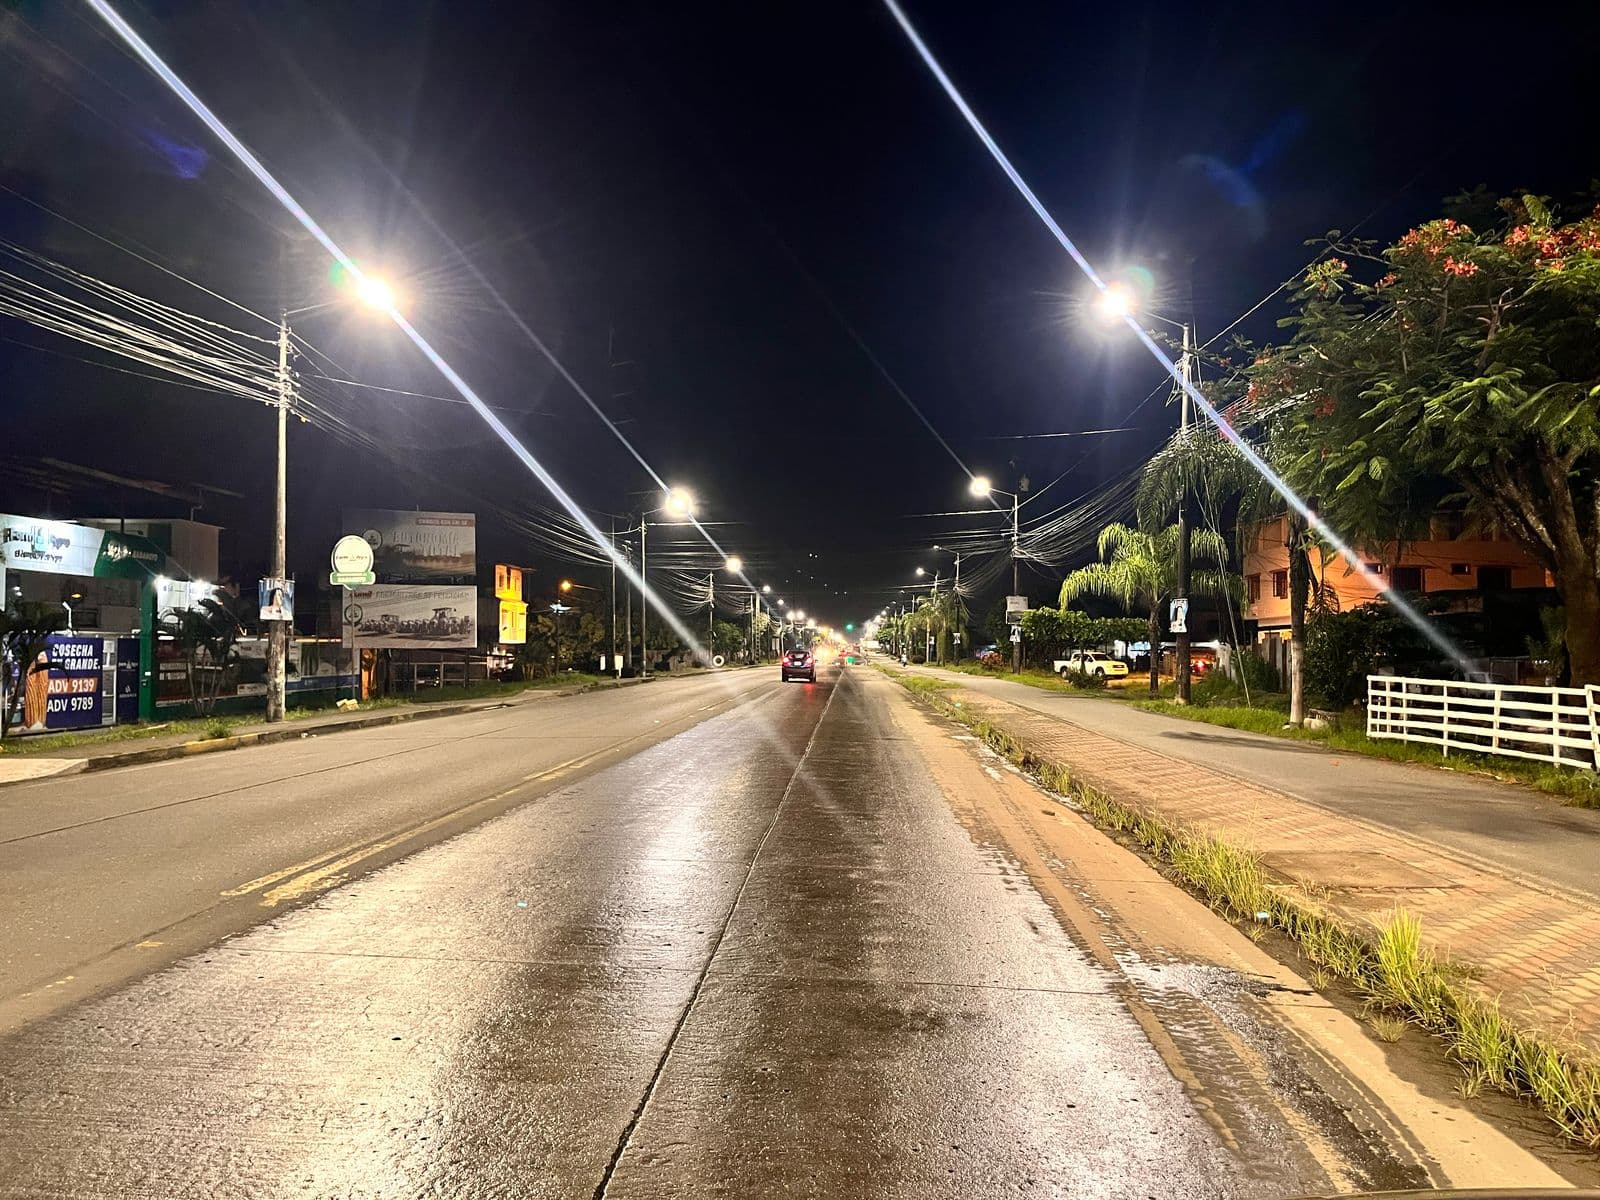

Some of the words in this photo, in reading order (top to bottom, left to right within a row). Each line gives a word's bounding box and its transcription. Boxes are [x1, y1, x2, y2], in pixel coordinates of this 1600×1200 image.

[52, 644, 93, 657] COSECHA
[48, 679, 69, 694] ADV
[72, 679, 95, 693] 9139
[47, 699, 68, 713] ADV
[71, 697, 93, 711] 9789
